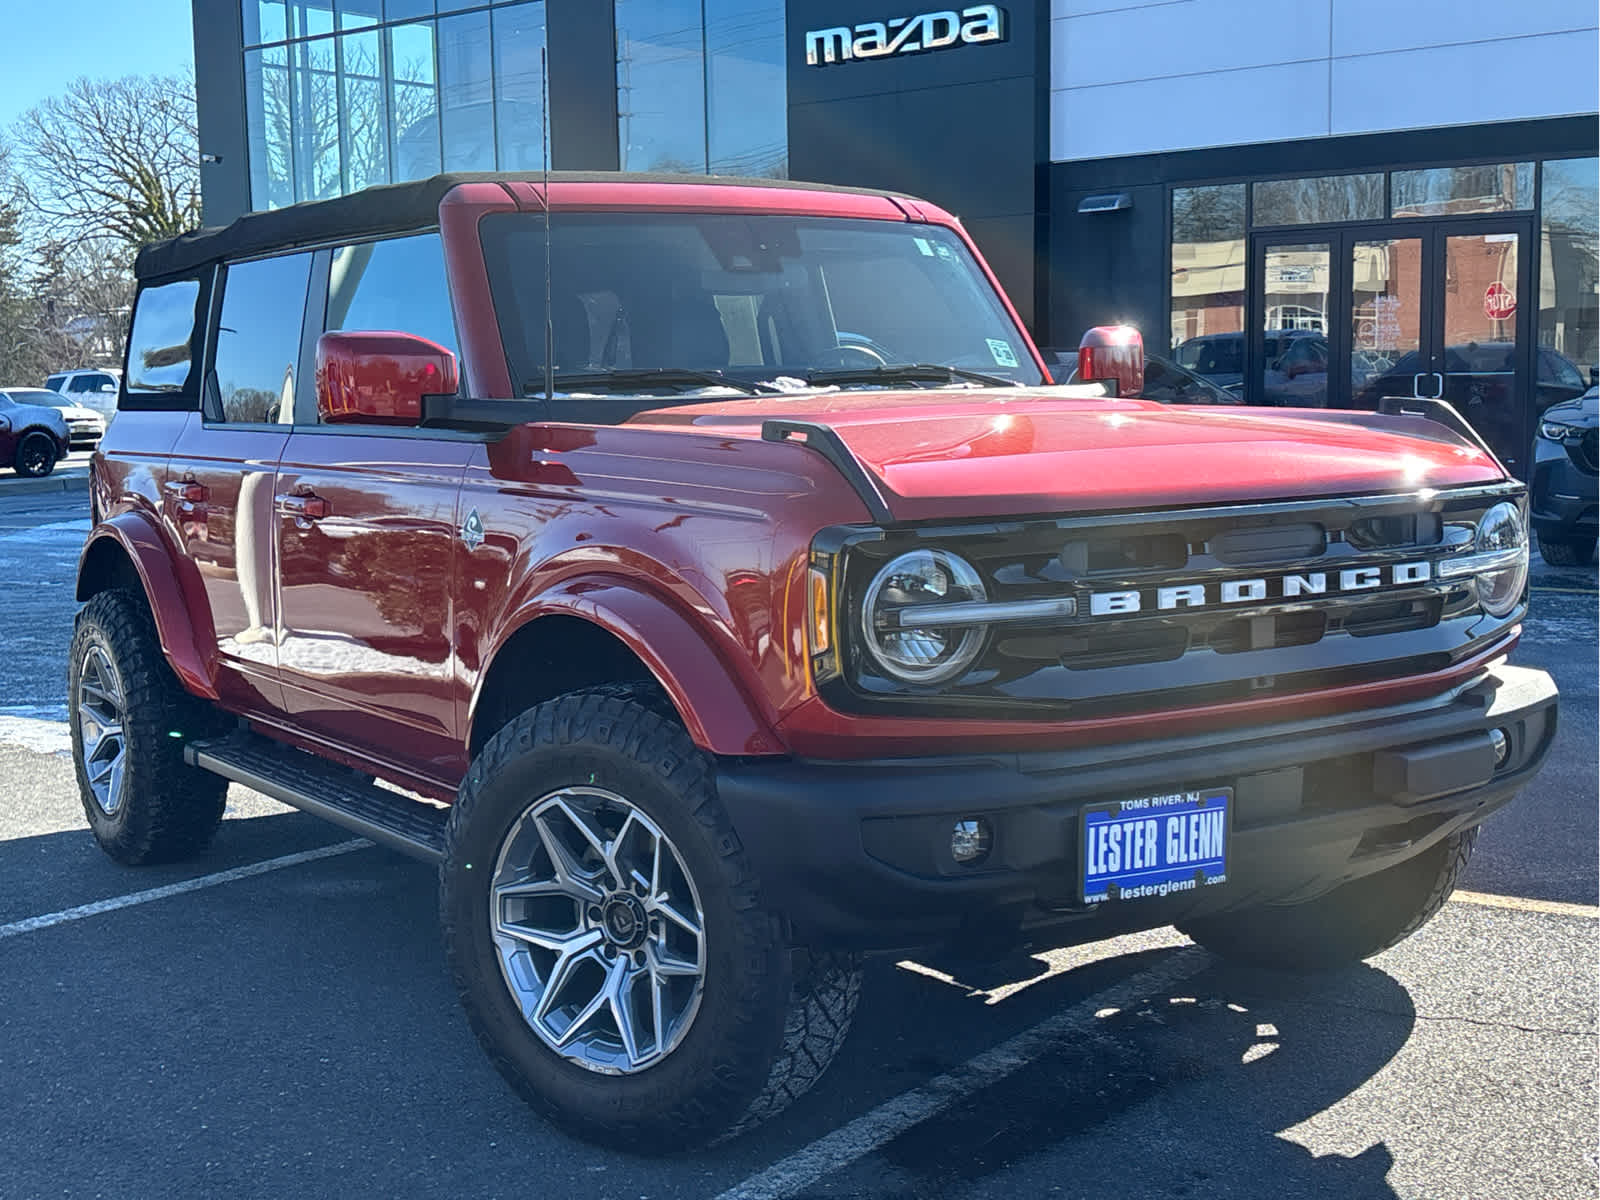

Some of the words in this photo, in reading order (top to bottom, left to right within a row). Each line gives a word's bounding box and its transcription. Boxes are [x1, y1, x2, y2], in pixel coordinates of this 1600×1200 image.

[1090, 562, 1431, 616] BRONCO
[1120, 799, 1150, 811] TOMS
[1186, 791, 1200, 803] NJ
[1087, 819, 1158, 875] LESTER
[1166, 811, 1225, 865] GLENN
[1120, 879, 1196, 900] lesterglenn
